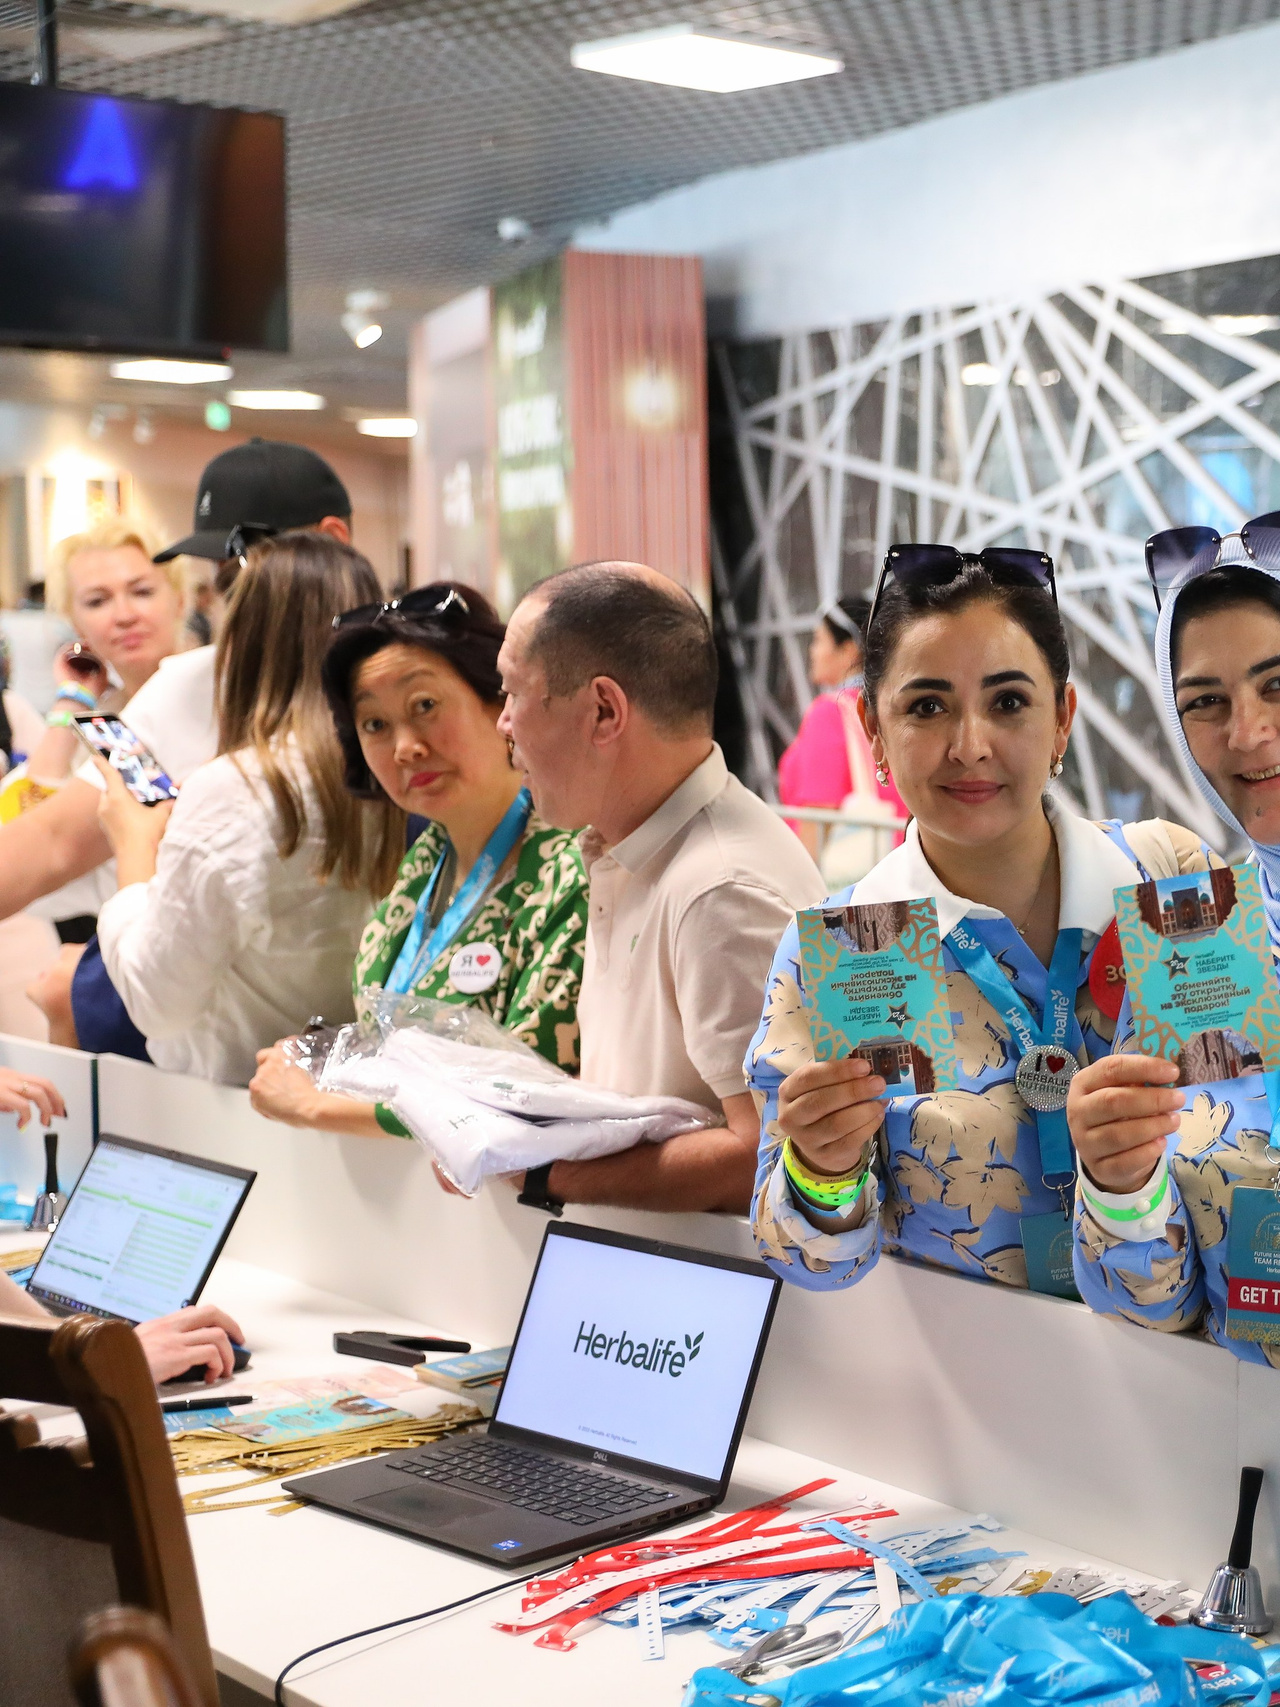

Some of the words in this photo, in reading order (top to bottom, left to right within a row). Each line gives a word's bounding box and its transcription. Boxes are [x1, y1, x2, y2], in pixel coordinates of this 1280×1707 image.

[1196, 954, 1236, 967] НАБЕРИТЕ
[850, 969, 894, 981] подарок!
[1197, 963, 1229, 974] ЗВЕЗДЫ
[831, 975, 903, 991] эксклюзивный
[843, 985, 888, 995] открытку
[1174, 976, 1231, 992] Обменяйте
[848, 990, 903, 1002] Обменяйте
[1161, 1002, 1173, 1010] на
[1174, 986, 1251, 1008] эксклюзивный
[1171, 992, 1187, 1001] эту
[1190, 983, 1237, 997] открытку
[850, 1006, 880, 1014] ЗВЕЗДЫ
[1184, 999, 1230, 1014] подарок!
[843, 1012, 881, 1022] НАБЕРИТЕ
[1019, 1071, 1071, 1087] HERBALIF
[1018, 1080, 1067, 1095] NUTRITIO
[1254, 1257, 1272, 1265] TEAM
[1240, 1286, 1268, 1304] GET
[573, 1321, 686, 1378] Herbalife
